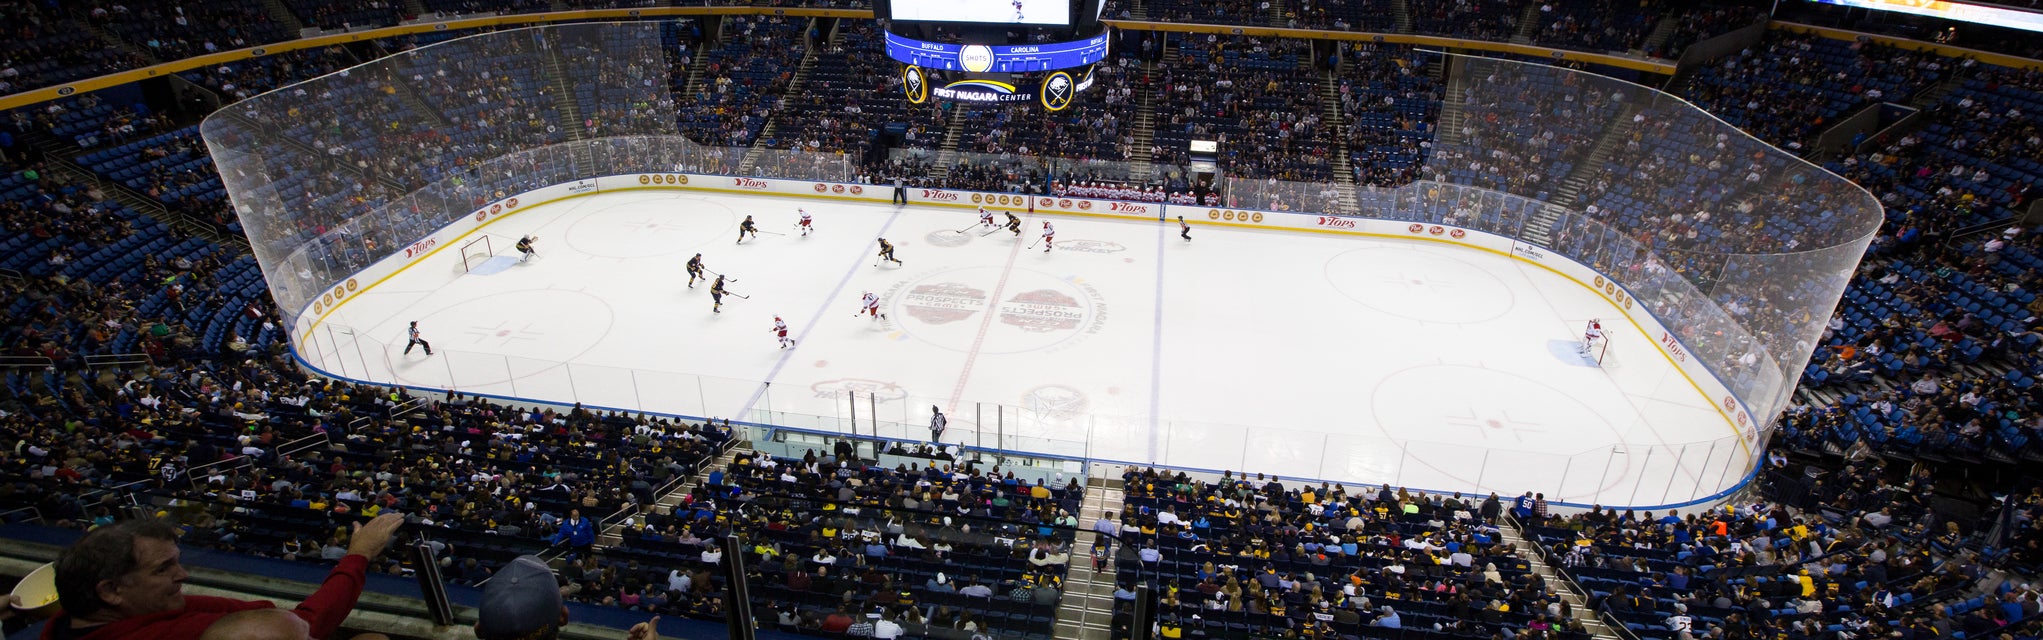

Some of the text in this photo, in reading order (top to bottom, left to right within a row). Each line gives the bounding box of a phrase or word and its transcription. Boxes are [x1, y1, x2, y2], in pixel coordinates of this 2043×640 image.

[921, 42, 944, 51] BUFFALO
[946, 61, 952, 69] 6
[1001, 63, 1006, 71] 1
[933, 87, 1031, 102] FIRST NIAGARA CENTER
[905, 294, 984, 306] PROSPECTS
[1001, 306, 1083, 319] PROSPECTS
[1522, 499, 1533, 510] 50
